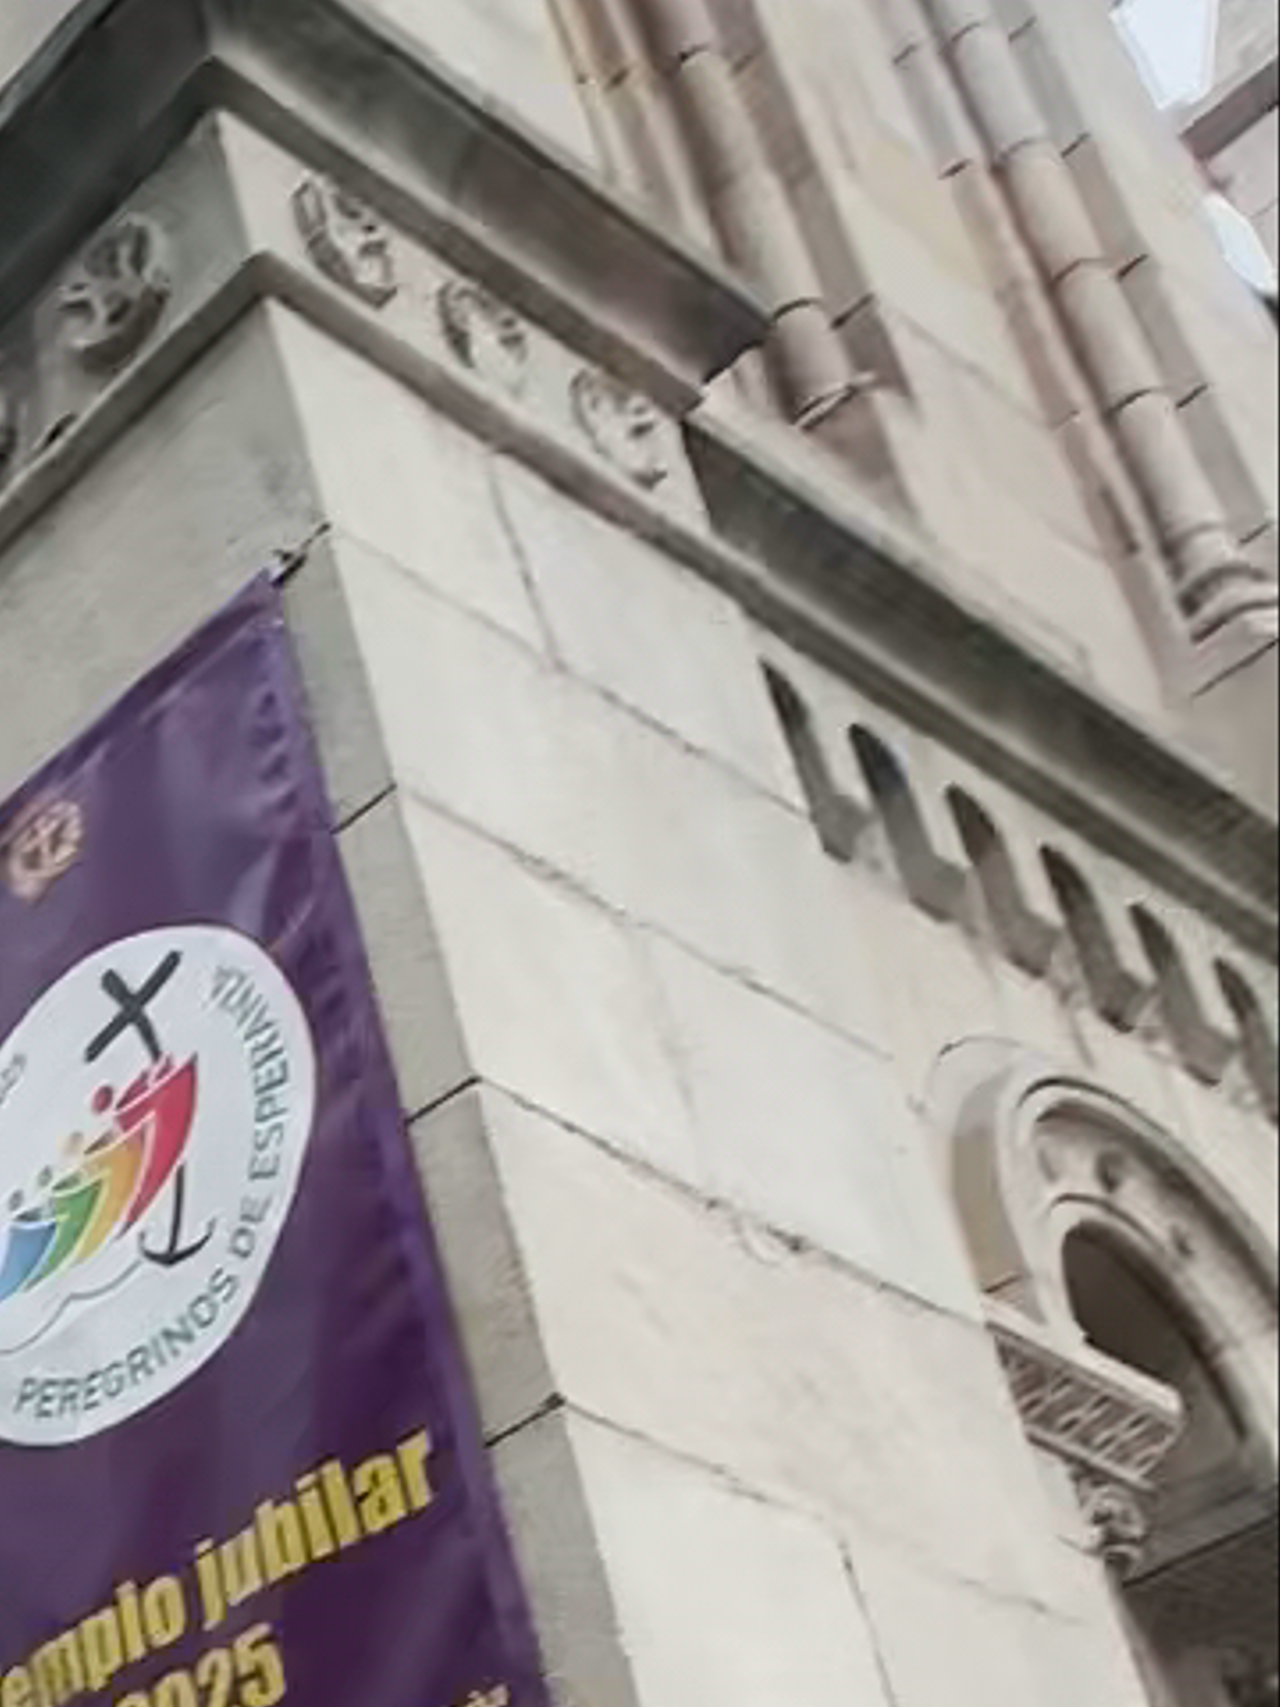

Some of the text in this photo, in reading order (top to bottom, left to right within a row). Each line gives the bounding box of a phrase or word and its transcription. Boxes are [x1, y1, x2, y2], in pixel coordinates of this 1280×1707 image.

[13, 1266, 240, 1419] PEREGRINOS
[227, 1193, 272, 1260] DE
[194, 1428, 434, 1632] jubilar
